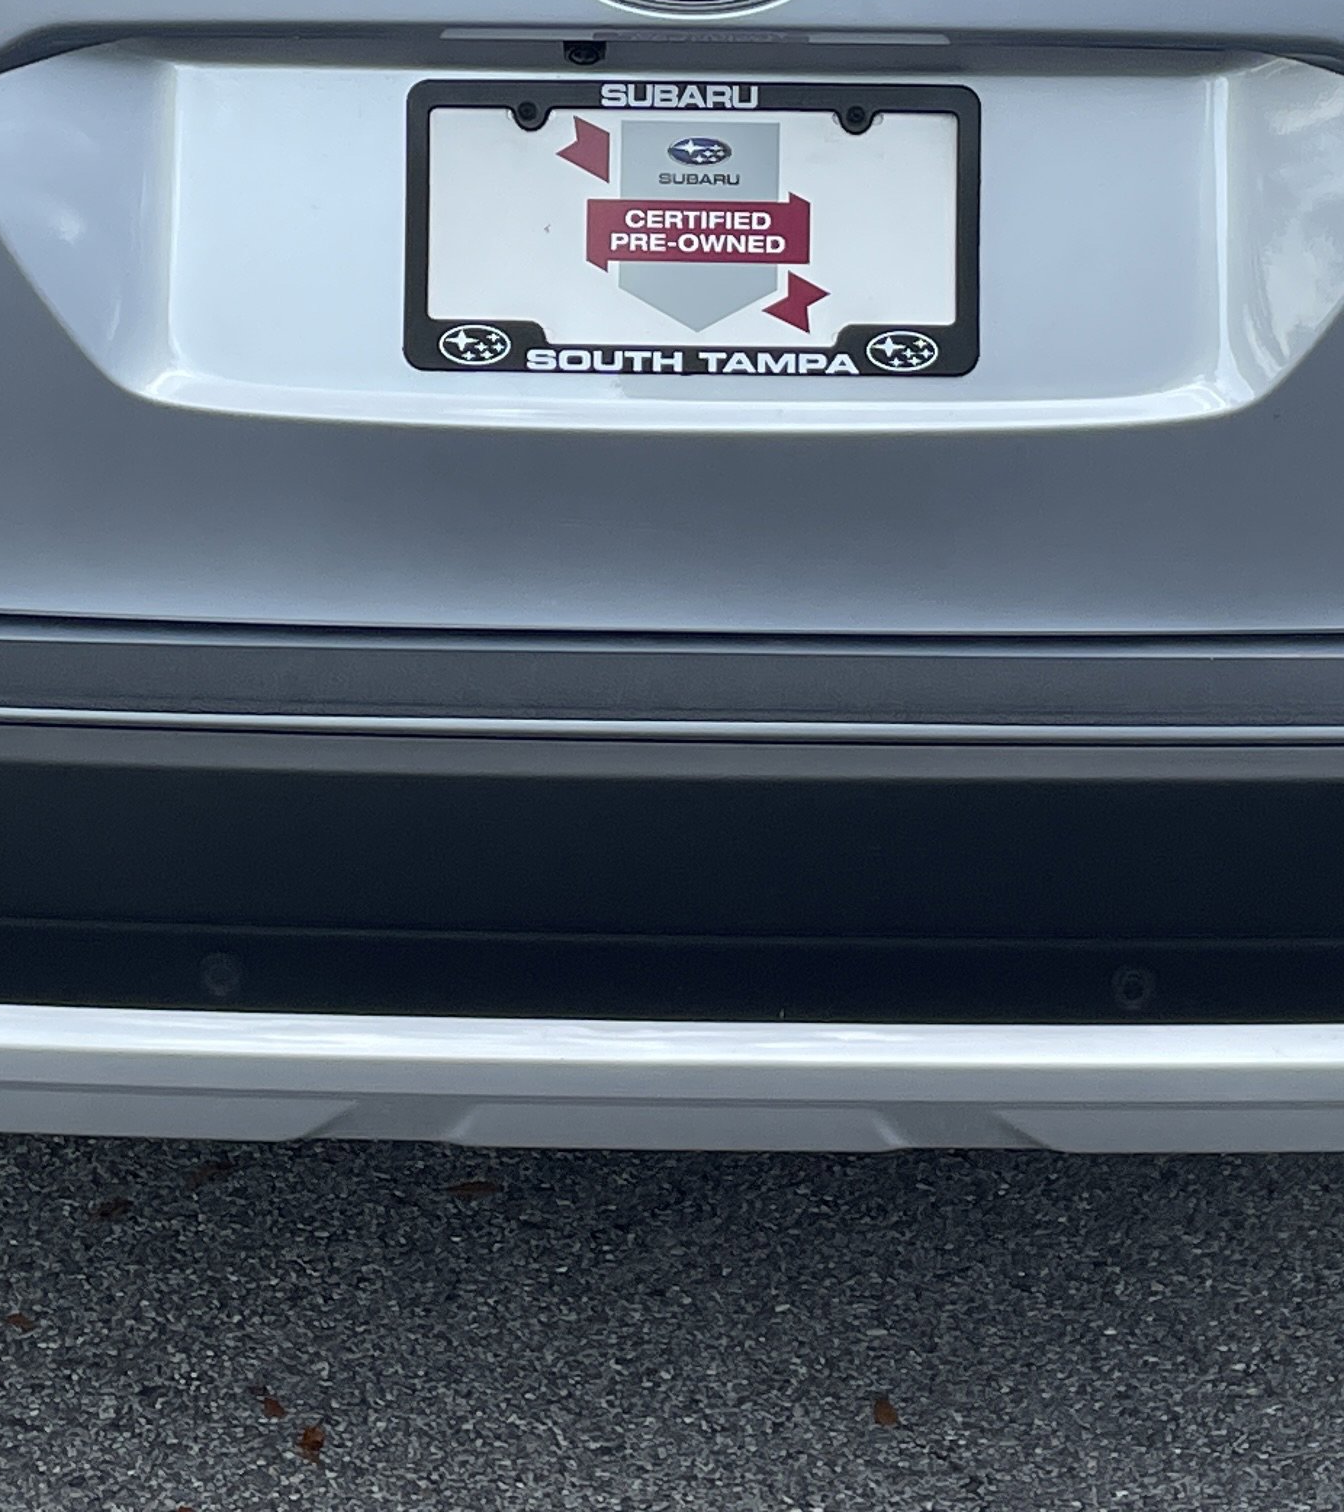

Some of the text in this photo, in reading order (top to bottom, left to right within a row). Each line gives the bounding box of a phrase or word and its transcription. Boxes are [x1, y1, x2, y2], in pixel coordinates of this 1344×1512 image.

[601, 83, 758, 109] SUBARU
[658, 172, 740, 186] SUBARU
[624, 209, 771, 231] CERTIFIED
[610, 233, 786, 254] PRE-OWNED
[526, 349, 859, 374] SOUTH TAMPA
